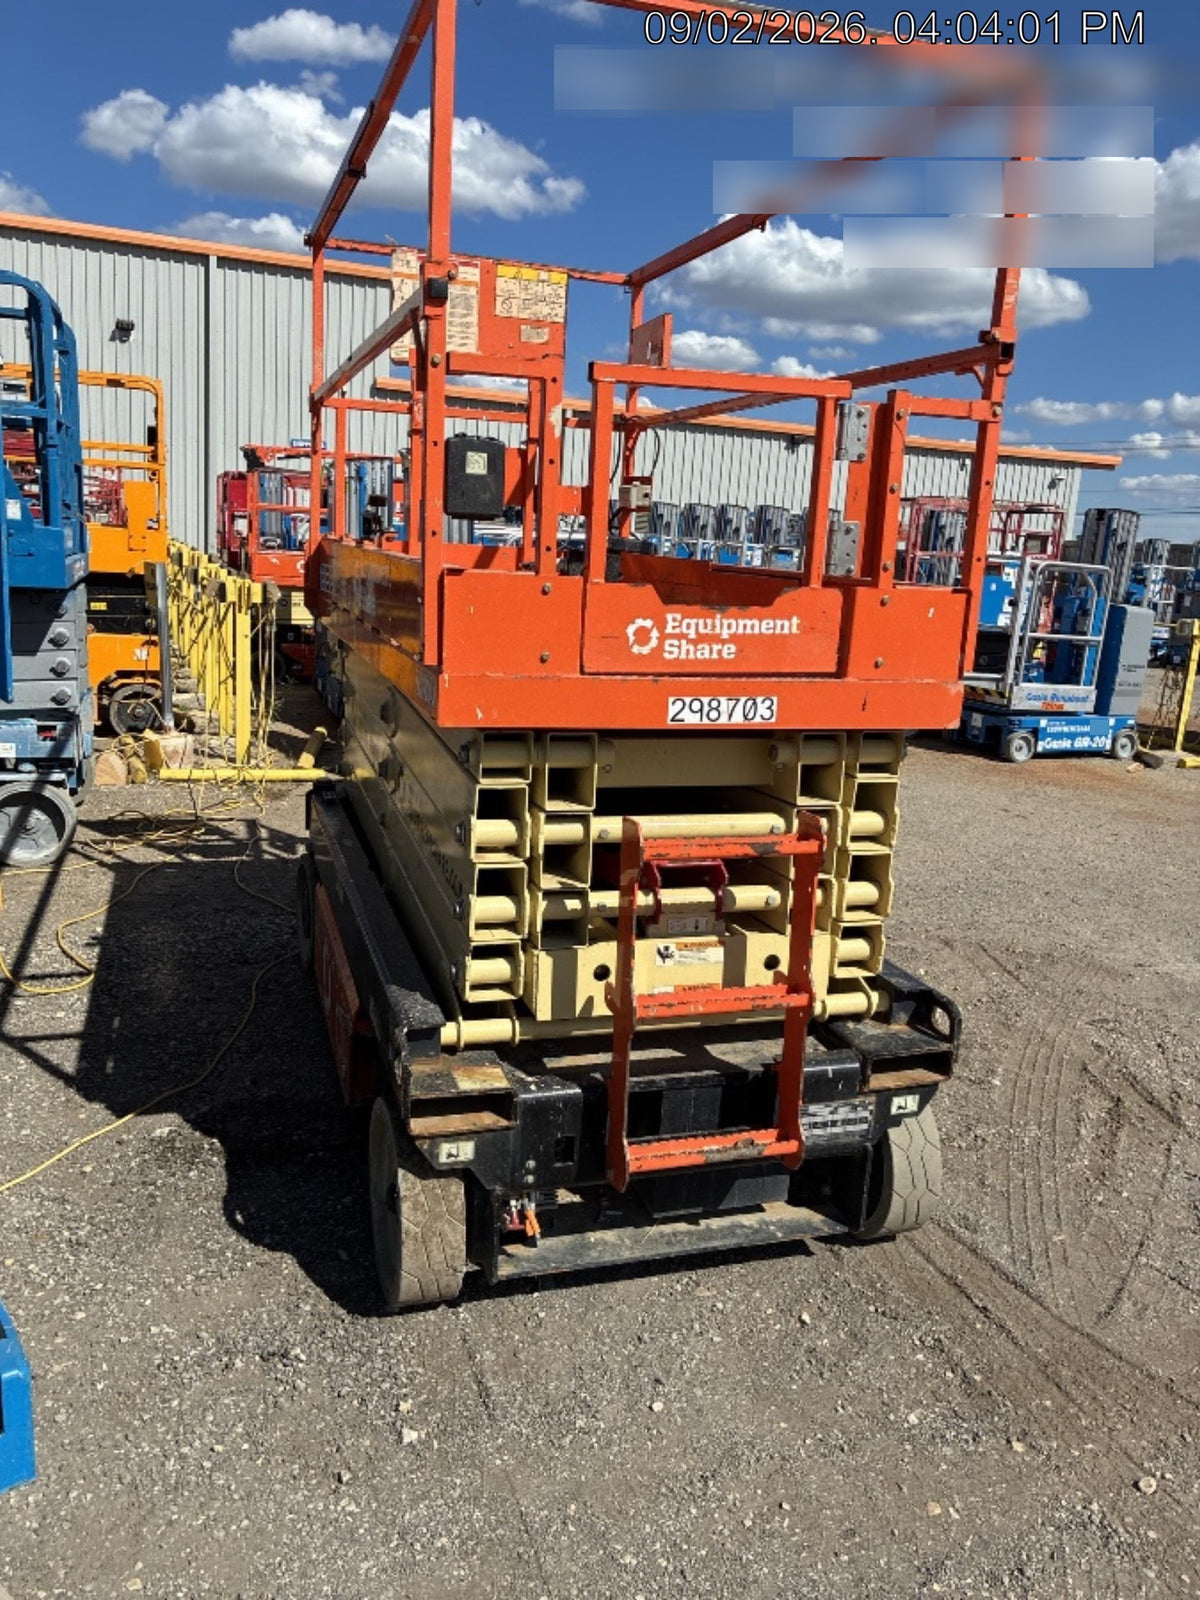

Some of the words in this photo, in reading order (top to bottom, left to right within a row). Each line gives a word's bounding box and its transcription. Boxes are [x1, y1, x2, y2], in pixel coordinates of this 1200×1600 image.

[664, 613, 800, 638] Equipment
[663, 639, 736, 660] Share
[669, 697, 775, 722] 298703
